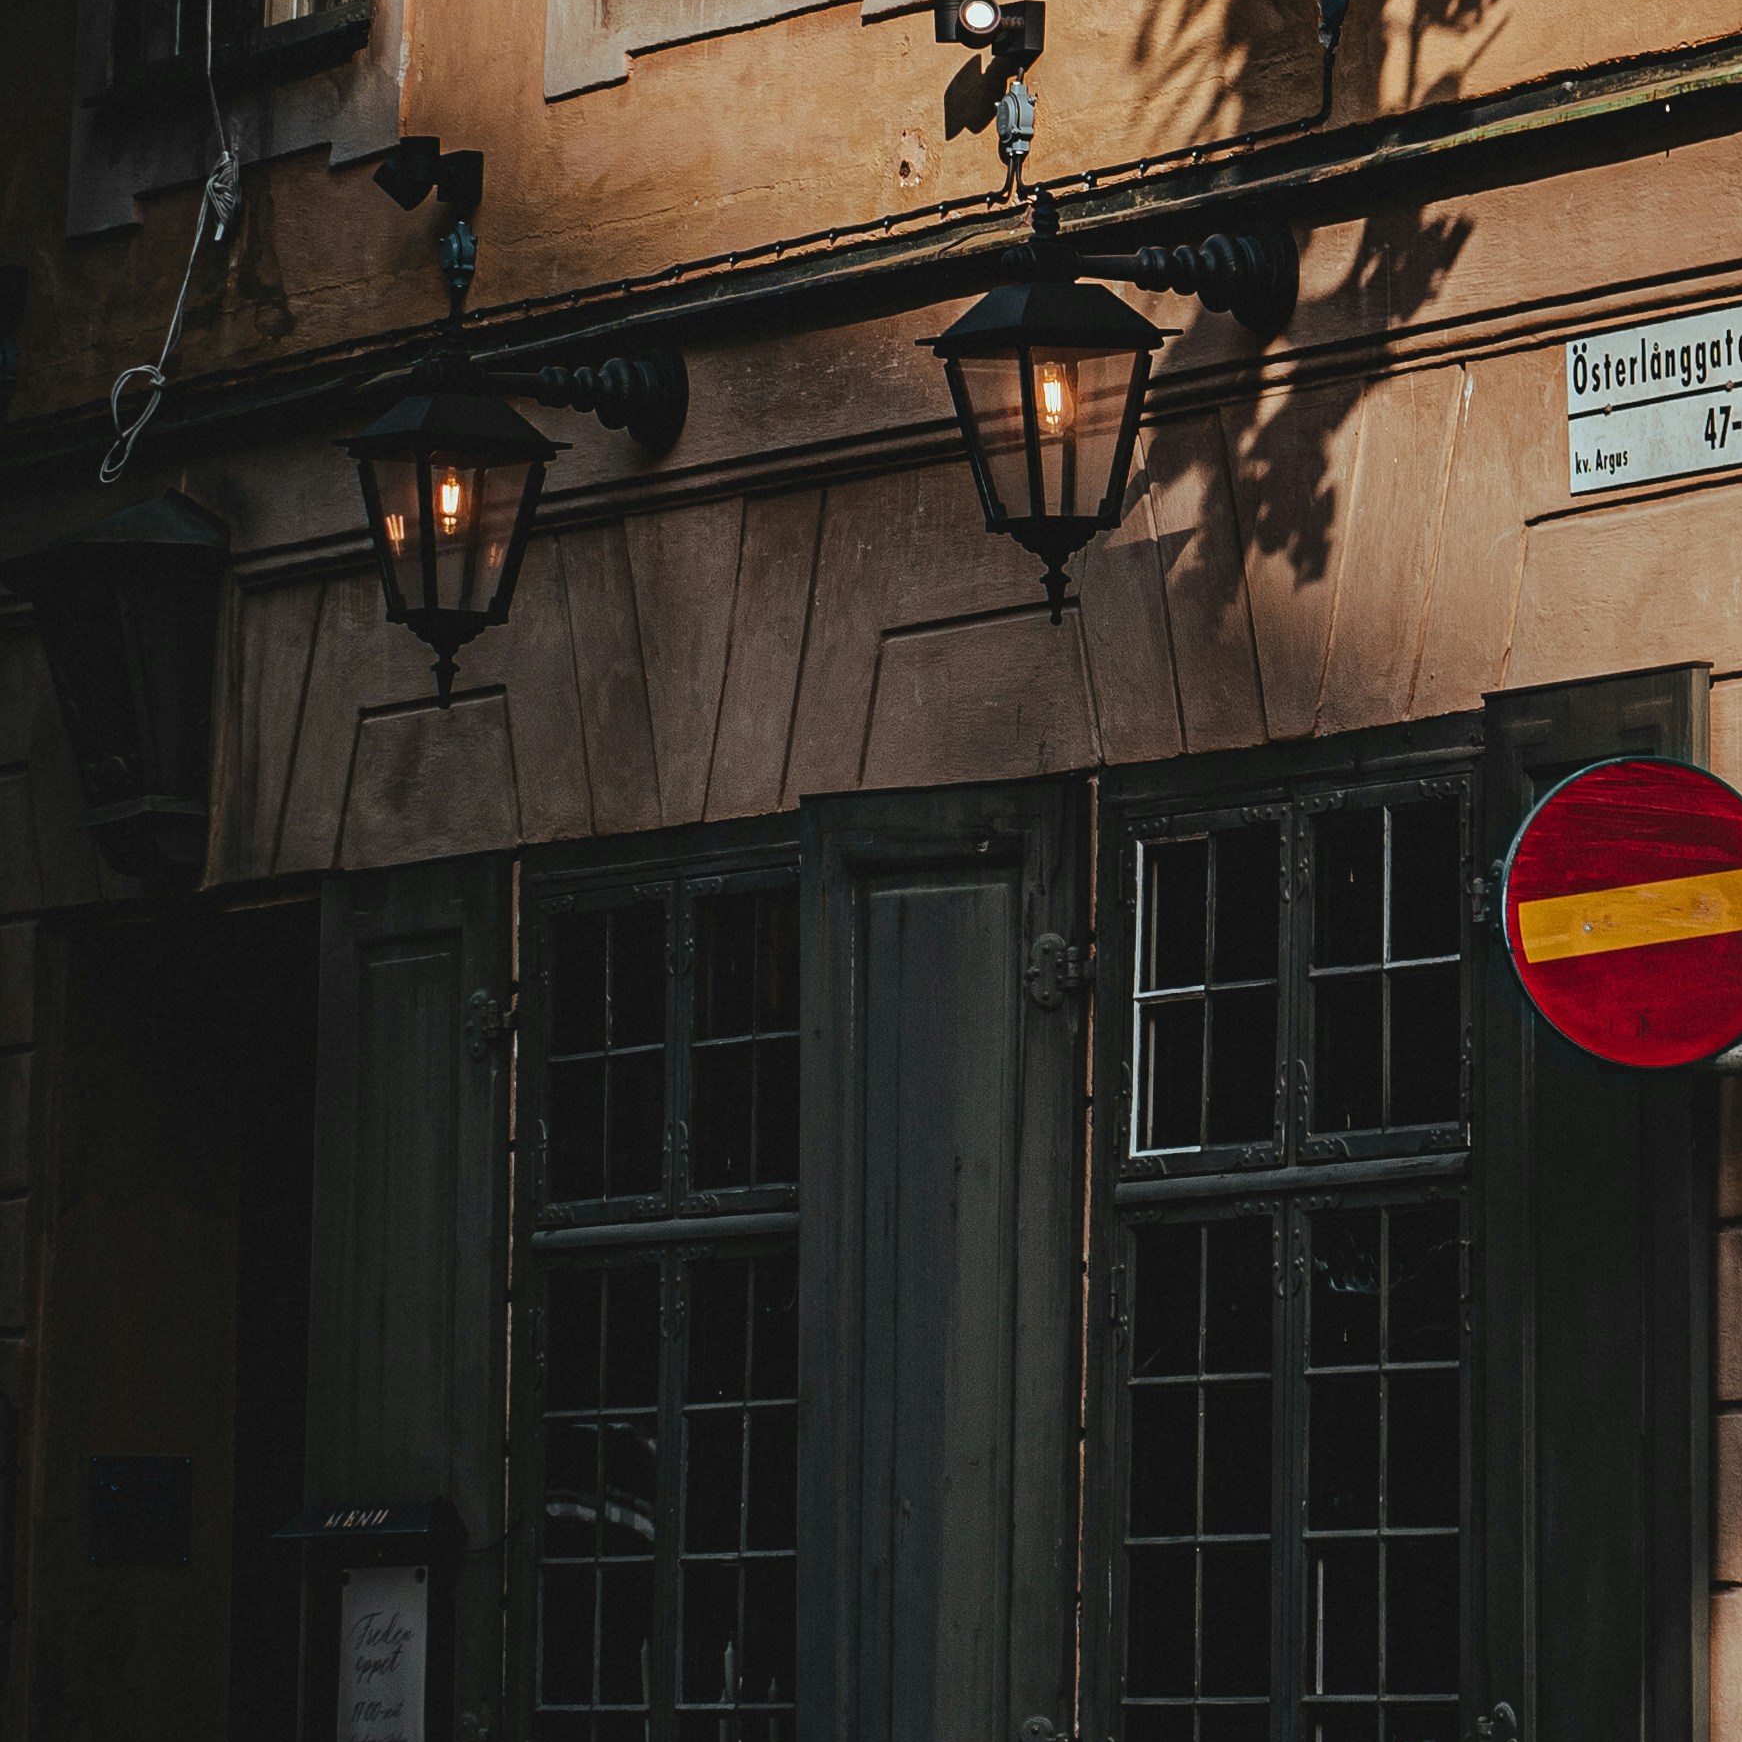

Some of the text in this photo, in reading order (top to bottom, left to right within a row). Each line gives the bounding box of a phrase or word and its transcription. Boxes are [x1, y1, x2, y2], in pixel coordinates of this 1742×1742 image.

[1575, 448, 1629, 475] kv. Argus
[323, 1508, 390, 1529] MENU
